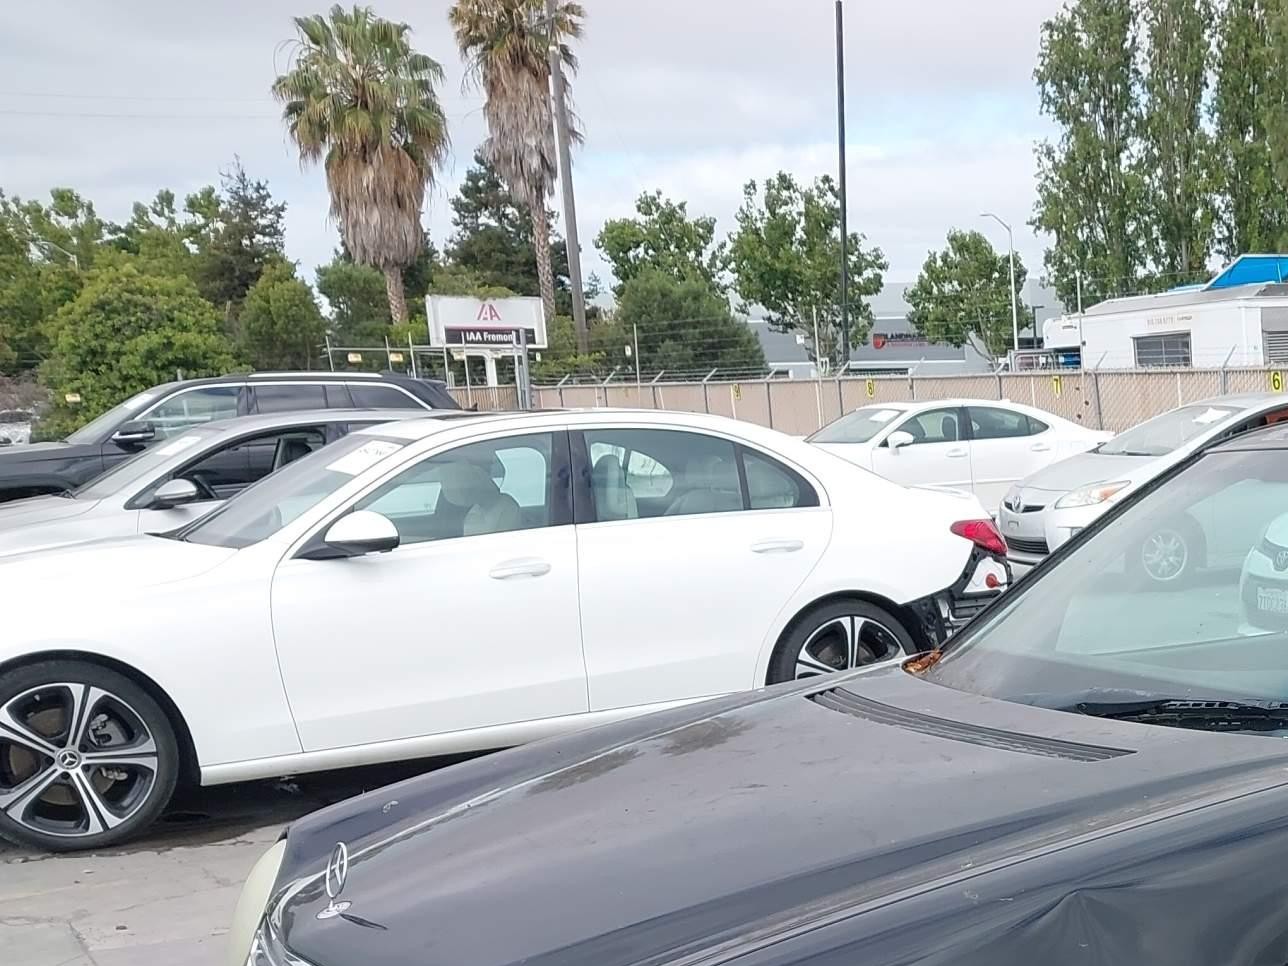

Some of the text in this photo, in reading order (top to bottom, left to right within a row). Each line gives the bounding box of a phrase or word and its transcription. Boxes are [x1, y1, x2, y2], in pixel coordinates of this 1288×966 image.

[483, 331, 514, 341] Fremon
[1053, 377, 1060, 394] 7
[1272, 371, 1281, 391] 6
